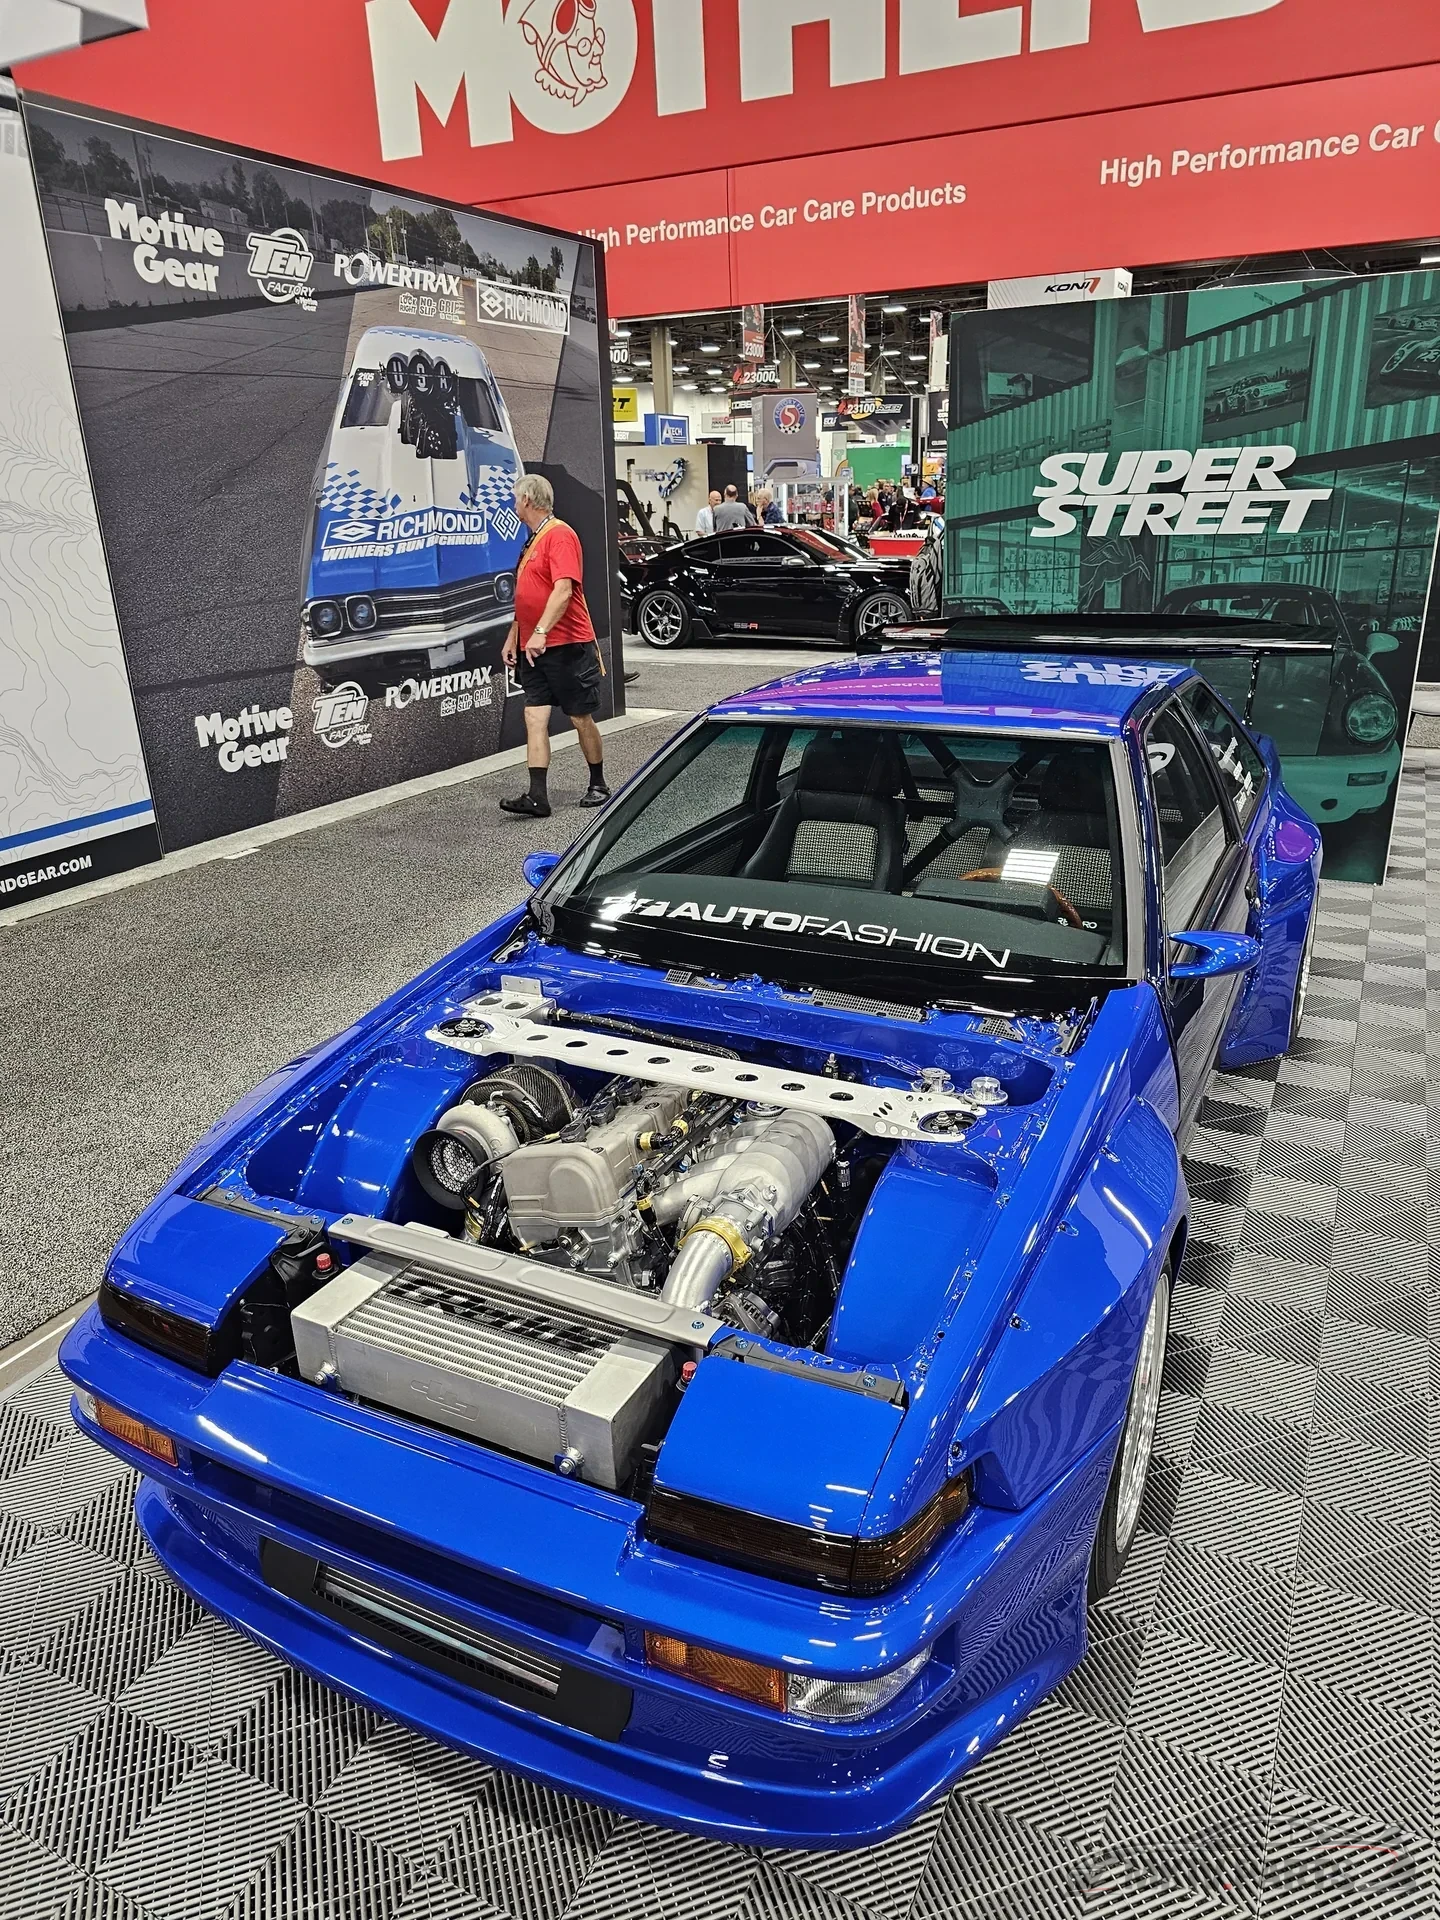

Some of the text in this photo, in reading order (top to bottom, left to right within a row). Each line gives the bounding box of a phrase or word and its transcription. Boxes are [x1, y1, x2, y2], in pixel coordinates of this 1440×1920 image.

[1099, 156, 1161, 189] High
[1171, 131, 1359, 175] Performance
[1369, 120, 1424, 153] Car
[104, 198, 225, 258] Motive
[626, 211, 754, 246] Performance
[760, 203, 796, 230] Car
[803, 196, 854, 223] Care
[861, 182, 967, 216] Products
[133, 246, 220, 293] Gear
[248, 234, 313, 280] TEN
[334, 251, 461, 297] POWERTRAX
[267, 282, 316, 298] FACTORY
[1043, 281, 1091, 294] KONI
[504, 292, 568, 328] RICHMOND
[743, 371, 776, 384] 23000
[847, 402, 876, 416] 23100
[1032, 445, 1297, 498] SUPER
[376, 509, 483, 541] RICHMOND
[1030, 489, 1333, 538] STREET
[322, 532, 490, 562] WINNERS RUN RICHMOND
[385, 665, 493, 709] POWERTRAX
[194, 703, 294, 748] Motive
[313, 692, 368, 733] TEN
[329, 723, 370, 741] FACTORY
[218, 735, 290, 773] Gear
[666, 901, 1011, 969] AUTOFASHION
